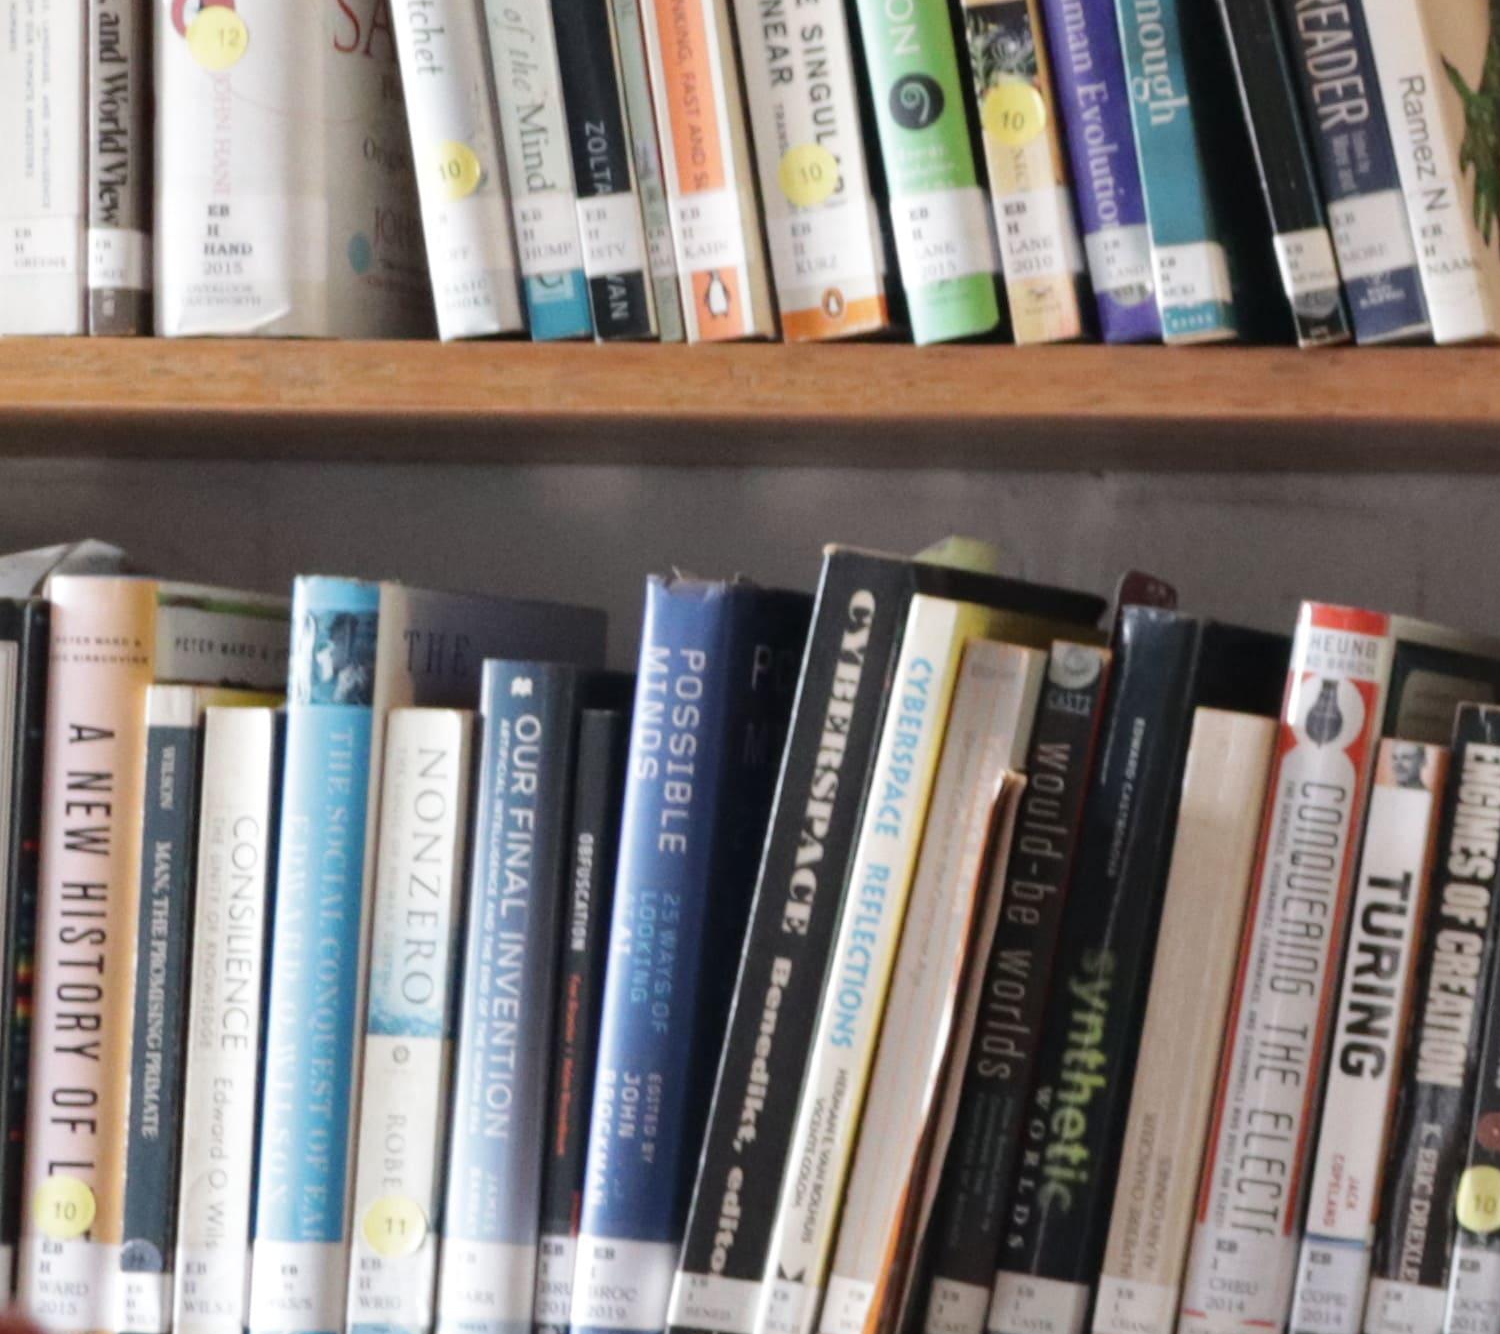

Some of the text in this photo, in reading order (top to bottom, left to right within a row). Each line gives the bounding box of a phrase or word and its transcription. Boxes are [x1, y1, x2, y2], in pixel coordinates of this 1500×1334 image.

[99, 11, 123, 65] and
[504, 11, 530, 42] of
[509, 46, 537, 94] the
[98, 160, 126, 227] View
[99, 71, 126, 156] World
[519, 101, 549, 195] Mind
[51, 723, 114, 1136] A NEW HISTORY OF
[402, 745, 449, 1006] NONZERO
[483, 712, 541, 1139] OUR FINAL INVENTION
[732, 589, 876, 1155] CYBERSPACE Benedikt,
[828, 656, 934, 1049] CYBERSPACE REFLECTIONS
[1254, 779, 1348, 1087] CONQUERING THE
[1443, 882, 1489, 924] OF
[1339, 870, 1415, 1080] TURING
[1415, 928, 1483, 1089] CREATION
